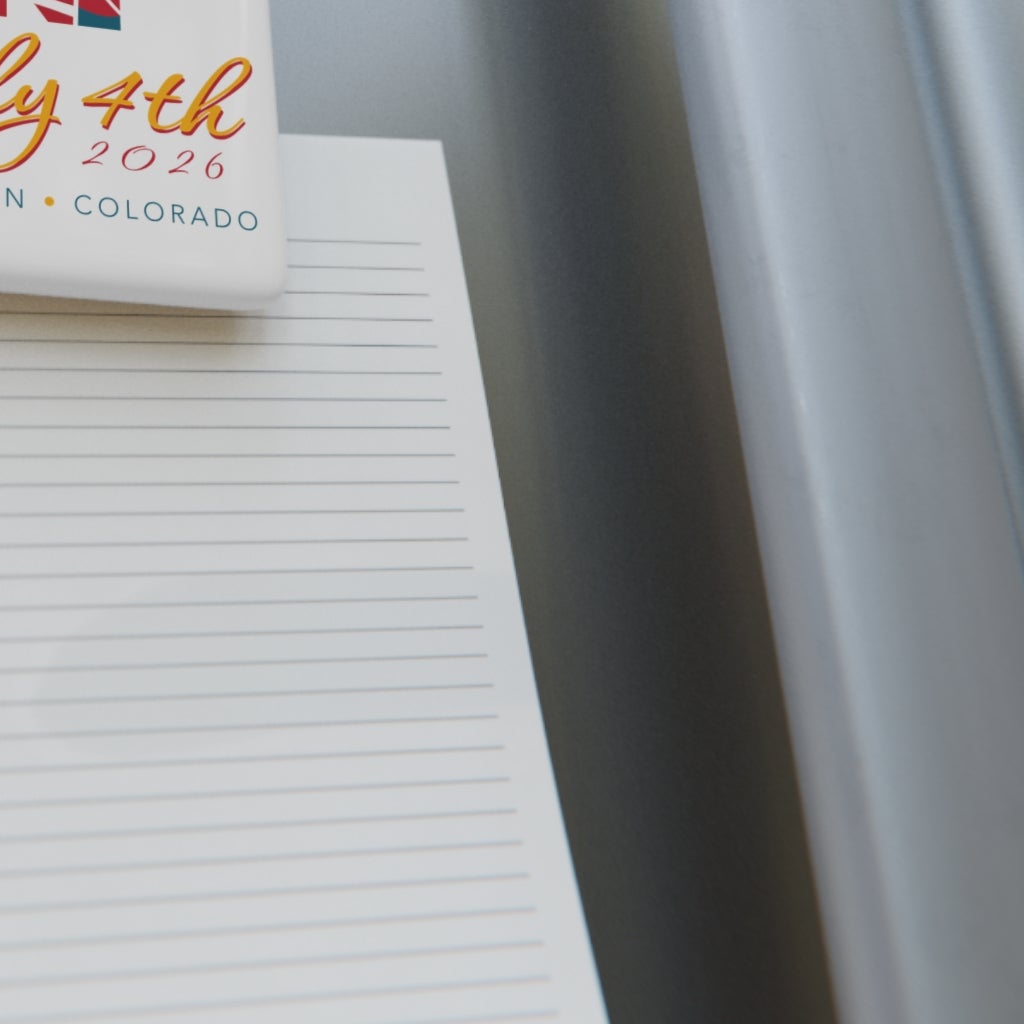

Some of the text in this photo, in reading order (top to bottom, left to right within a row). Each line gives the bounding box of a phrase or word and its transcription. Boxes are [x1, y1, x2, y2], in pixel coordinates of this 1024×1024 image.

[81, 56, 253, 141] 4th
[82, 141, 225, 180] 2026
[74, 194, 259, 232] COLORADO
